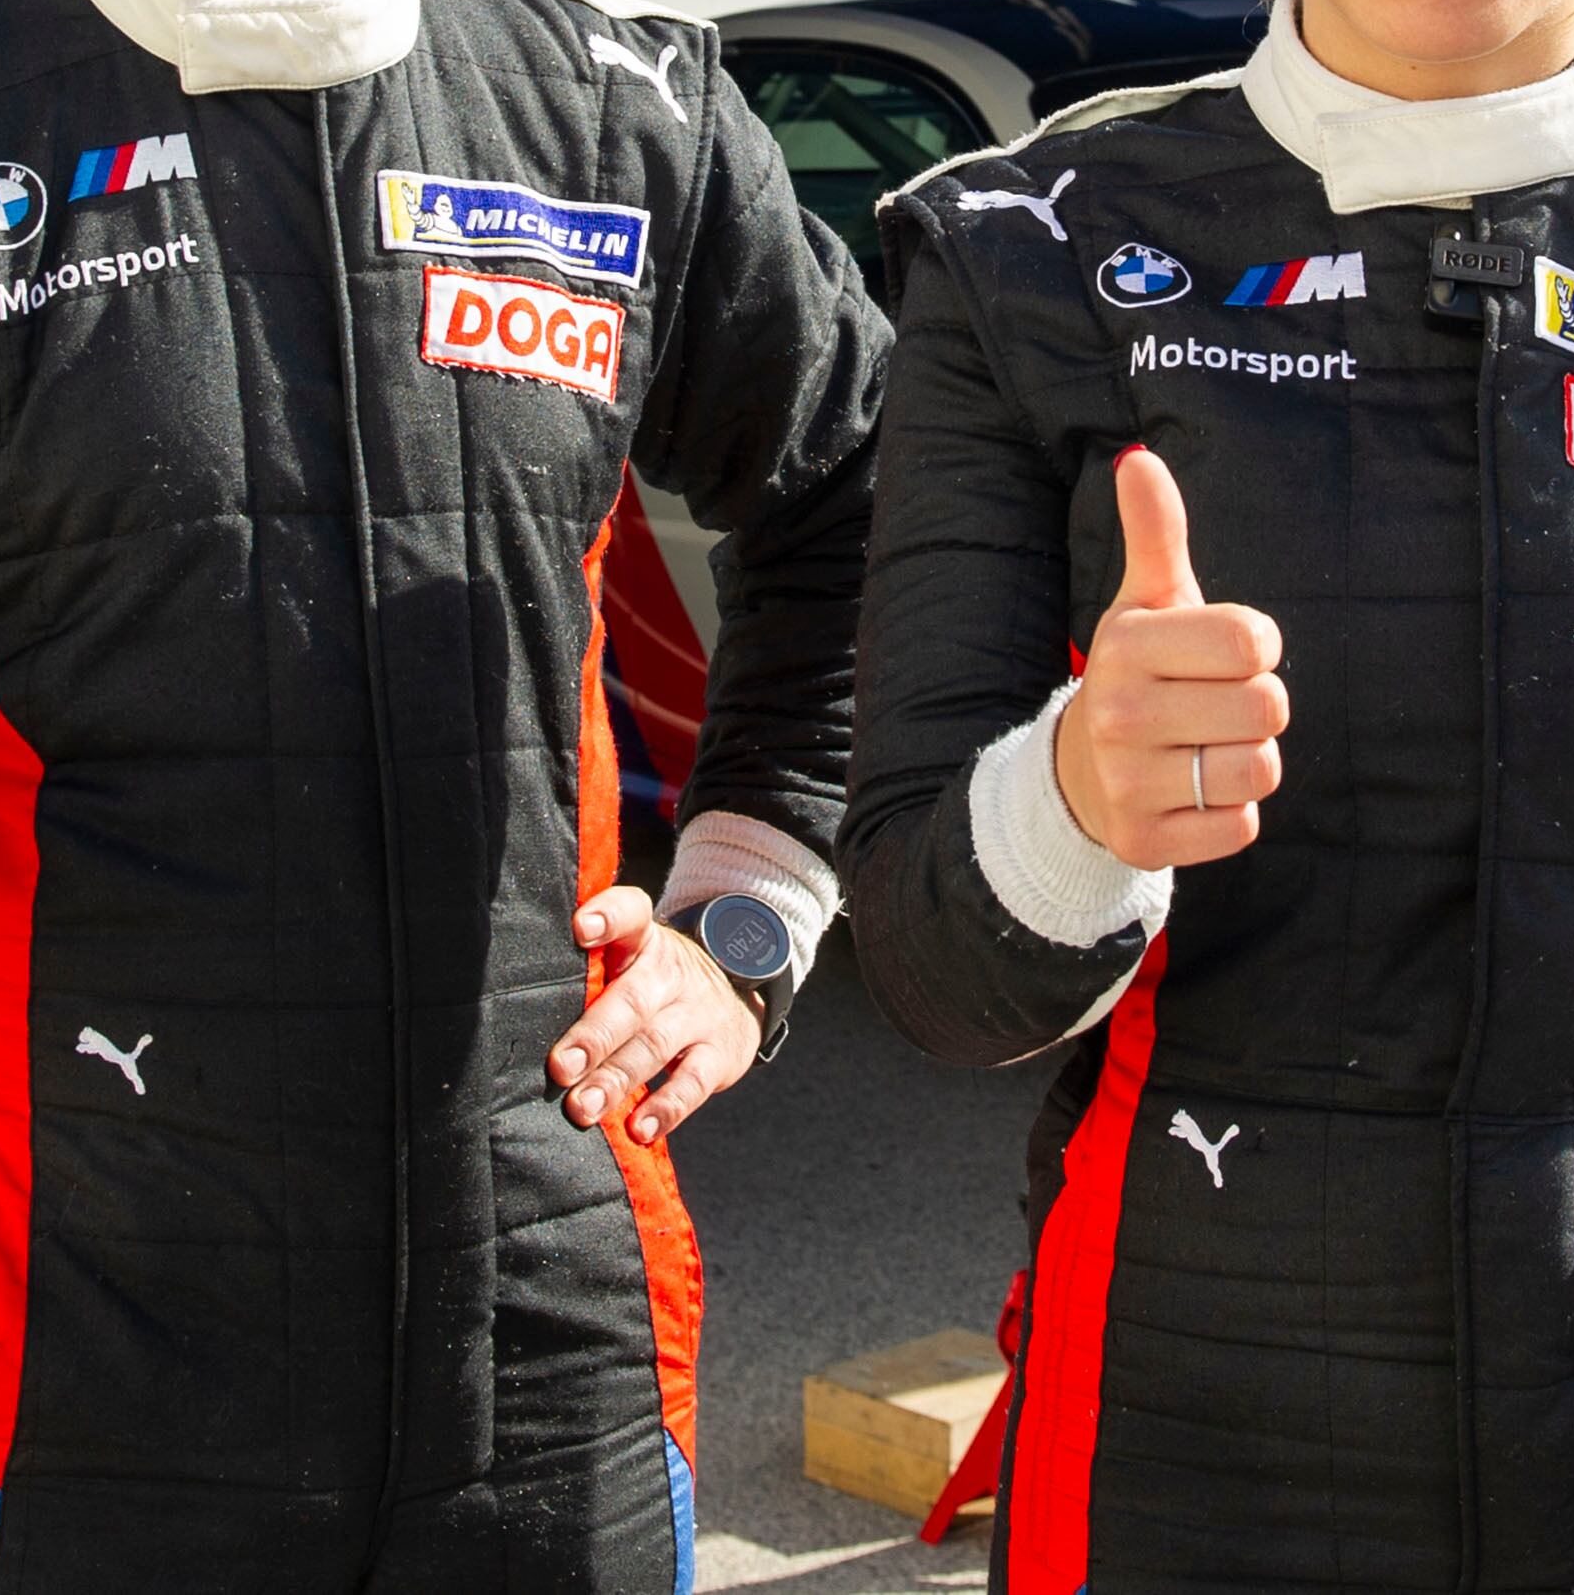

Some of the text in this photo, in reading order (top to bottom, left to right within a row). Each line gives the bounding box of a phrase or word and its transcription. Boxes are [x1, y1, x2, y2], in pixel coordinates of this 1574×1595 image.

[465, 209, 629, 258] MICHELIN
[444, 288, 613, 379] DOGA
[1129, 334, 1358, 383] Motorsport
[726, 919, 767, 960] 17:40
